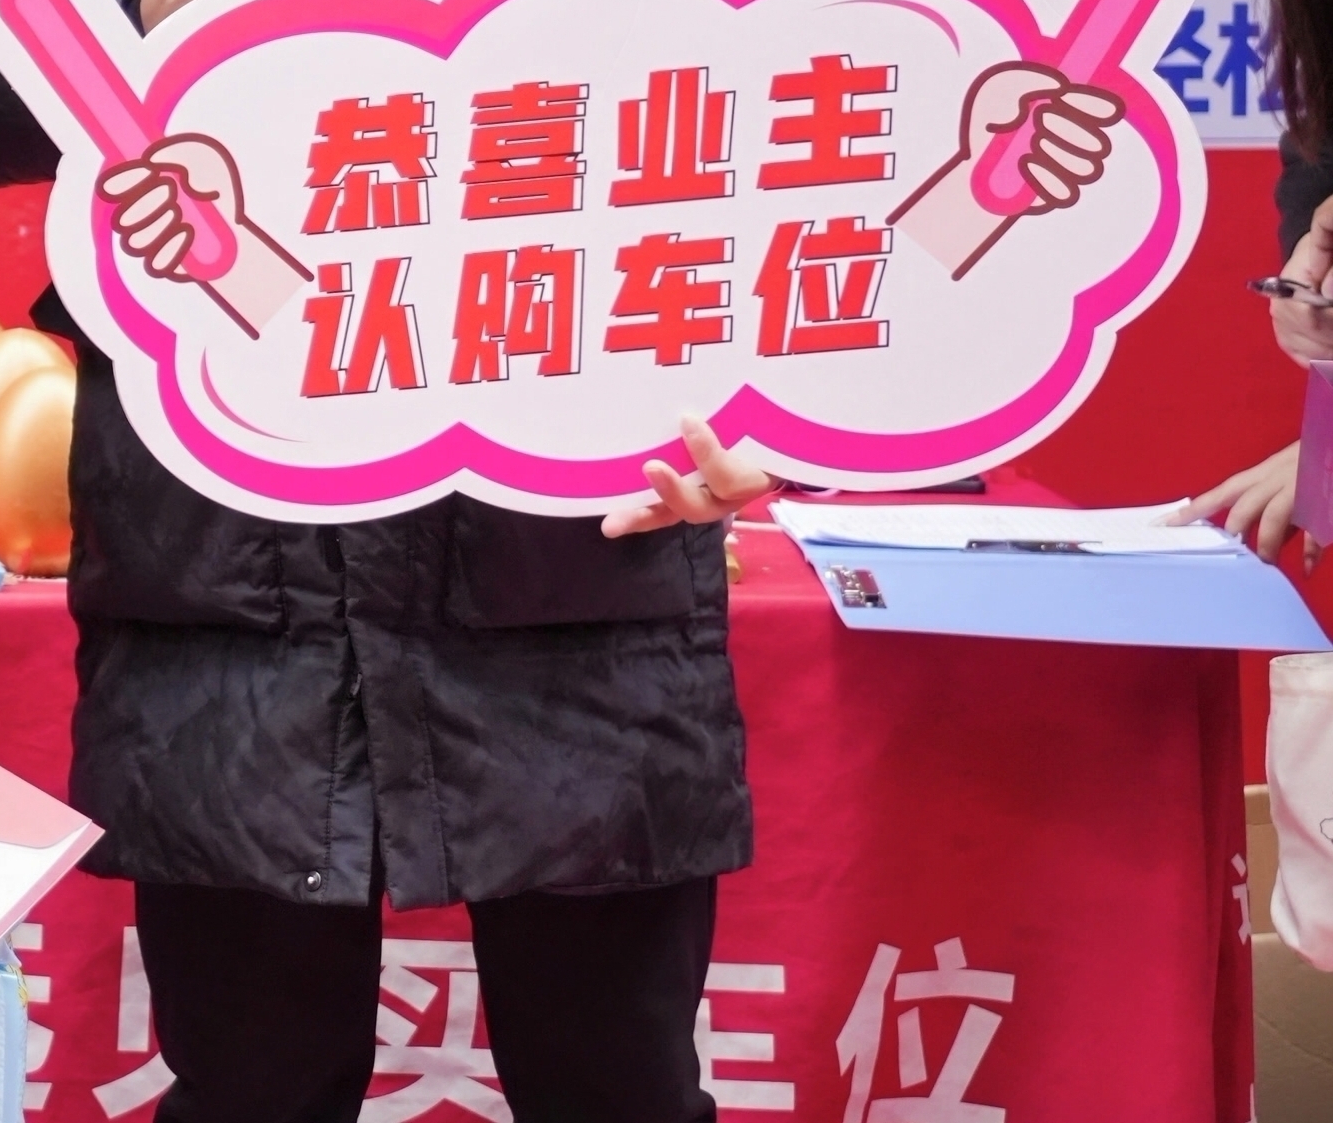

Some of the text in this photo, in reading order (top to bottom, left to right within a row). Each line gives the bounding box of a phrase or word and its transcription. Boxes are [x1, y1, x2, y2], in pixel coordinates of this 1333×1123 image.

[300, 54, 897, 235] 恭喜业主
[300, 216, 894, 399] 认购车位
